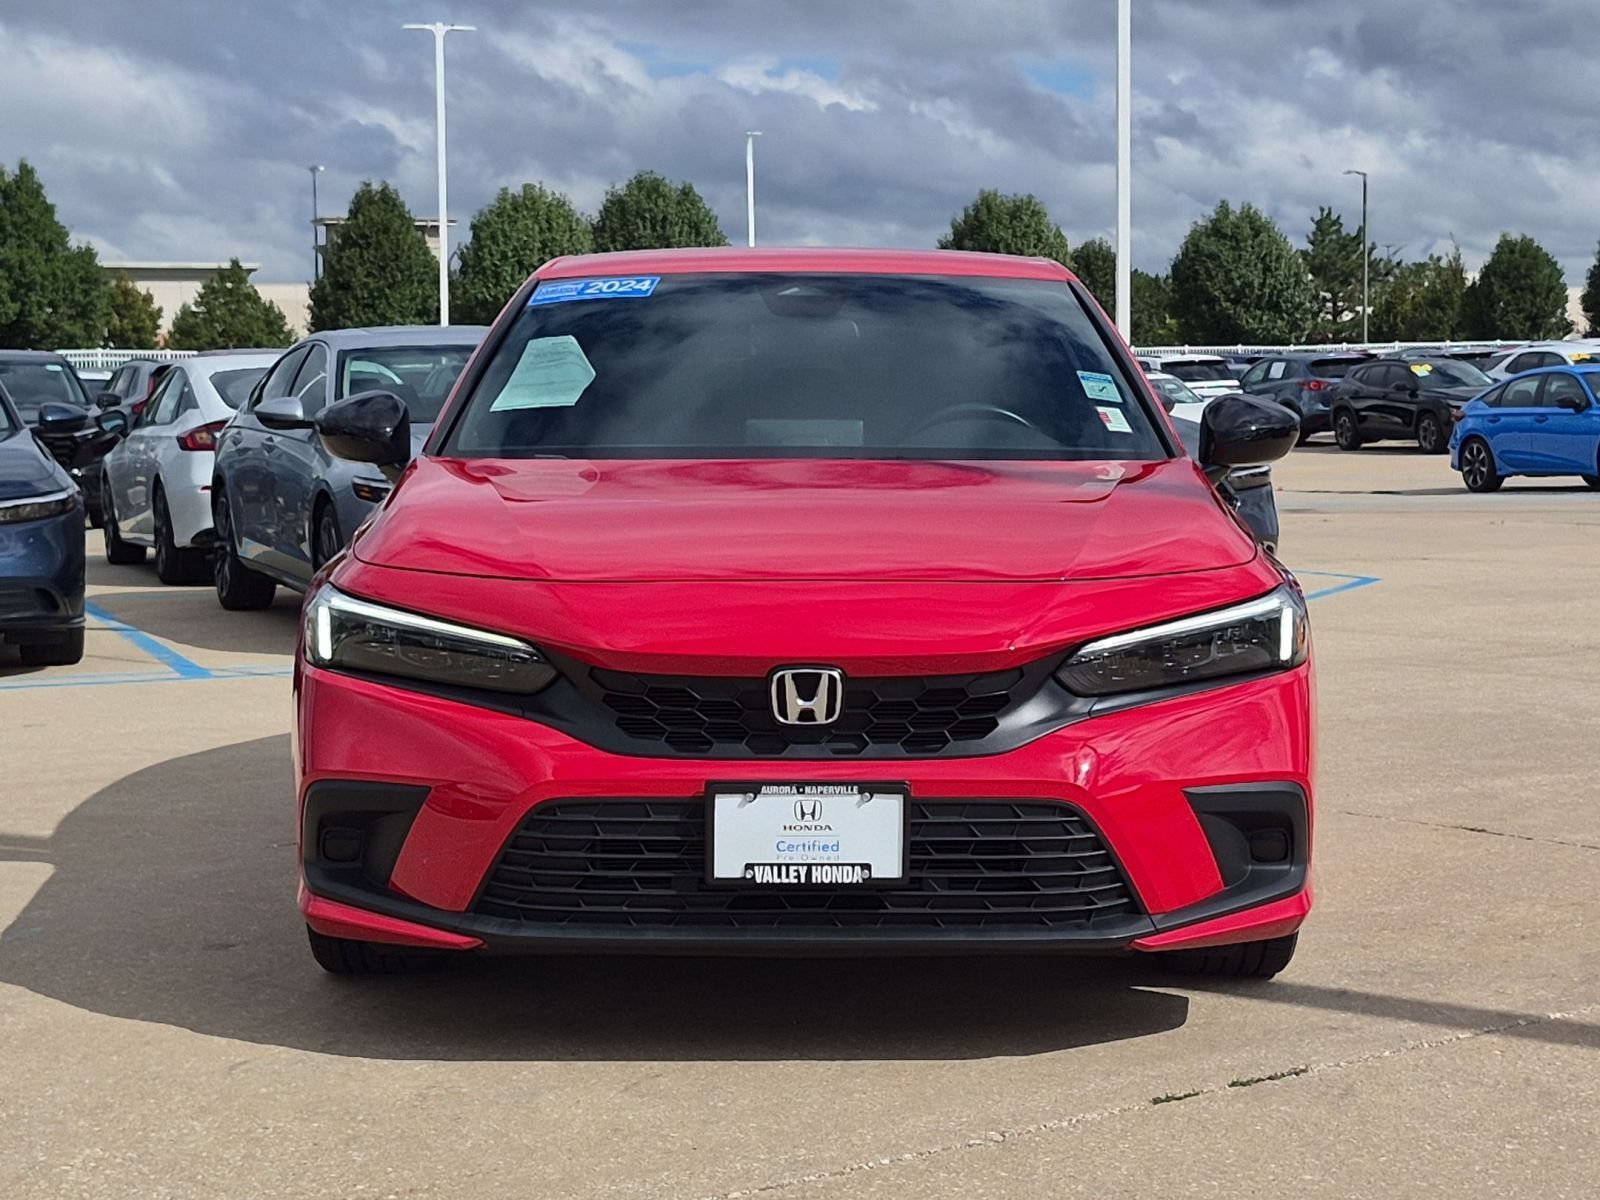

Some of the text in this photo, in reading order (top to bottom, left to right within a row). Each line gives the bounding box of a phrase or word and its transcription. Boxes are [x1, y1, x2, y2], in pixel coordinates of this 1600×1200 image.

[584, 279, 652, 294] 2024
[760, 785, 859, 795] AURORA NAPERVILLE
[783, 824, 833, 832] HONDA
[775, 840, 840, 853] Certified
[753, 865, 864, 884] VALLEY HONDA
